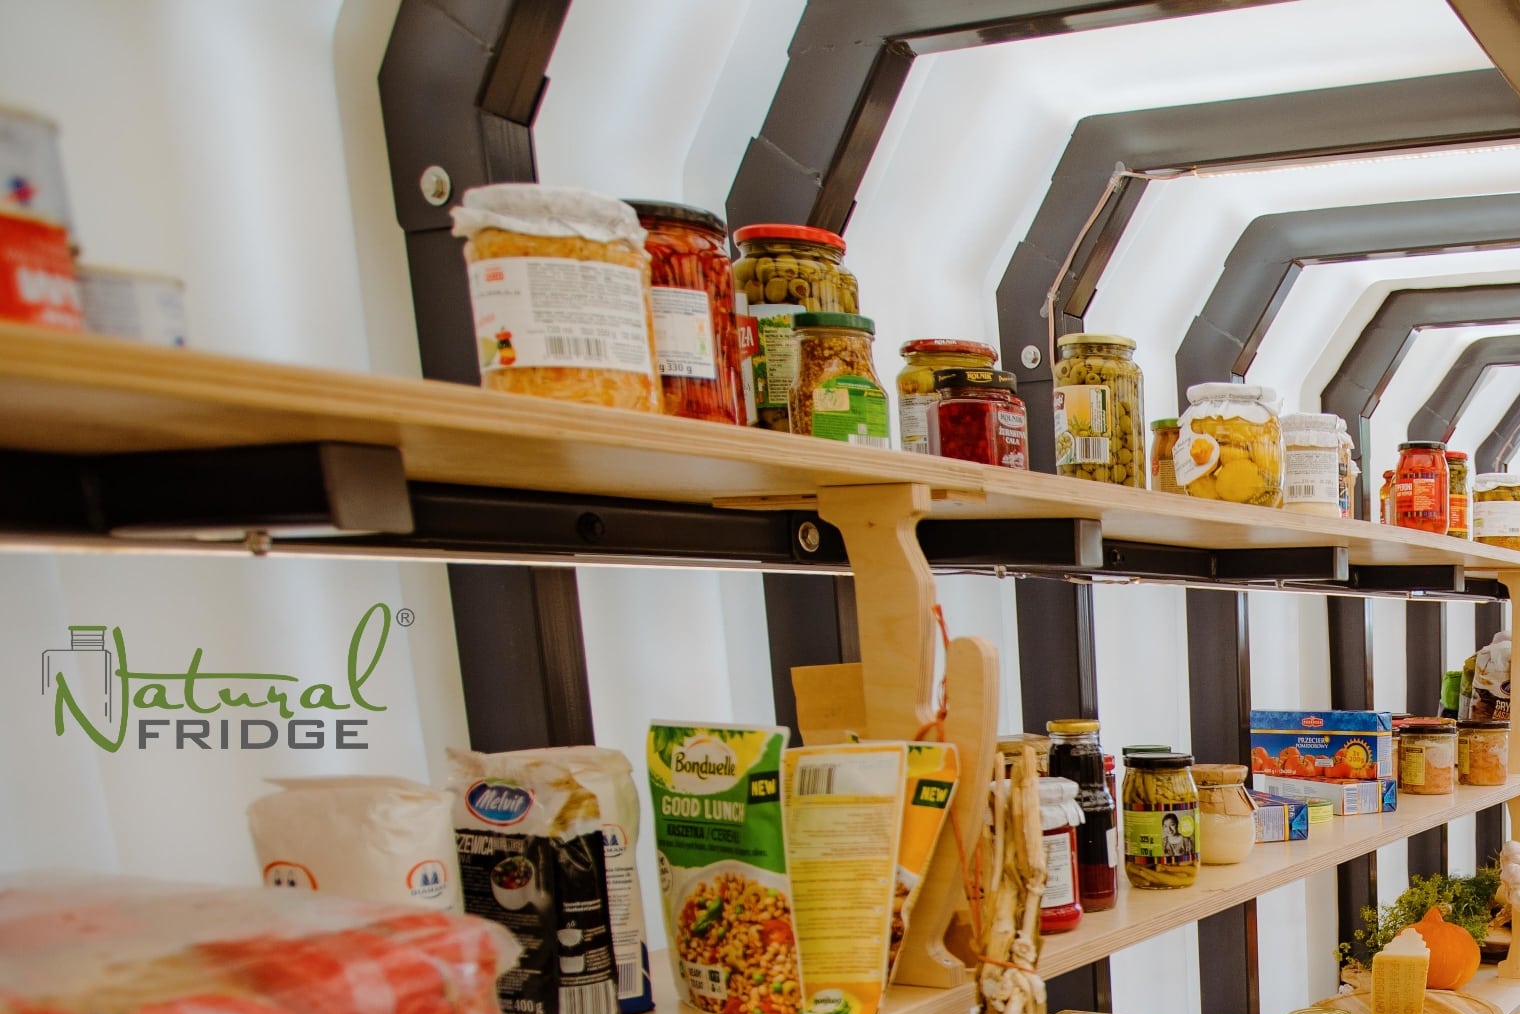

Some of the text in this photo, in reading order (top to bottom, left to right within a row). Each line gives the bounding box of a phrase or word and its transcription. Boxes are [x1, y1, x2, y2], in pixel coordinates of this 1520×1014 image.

[667, 362, 684, 372] 330
[674, 752, 736, 780] Bonduelle
[751, 779, 776, 797] NEW
[919, 785, 949, 804] NEW
[476, 788, 525, 812] Melvit
[662, 796, 745, 824] GOOD LUNCH
[515, 999, 533, 1012] 400
